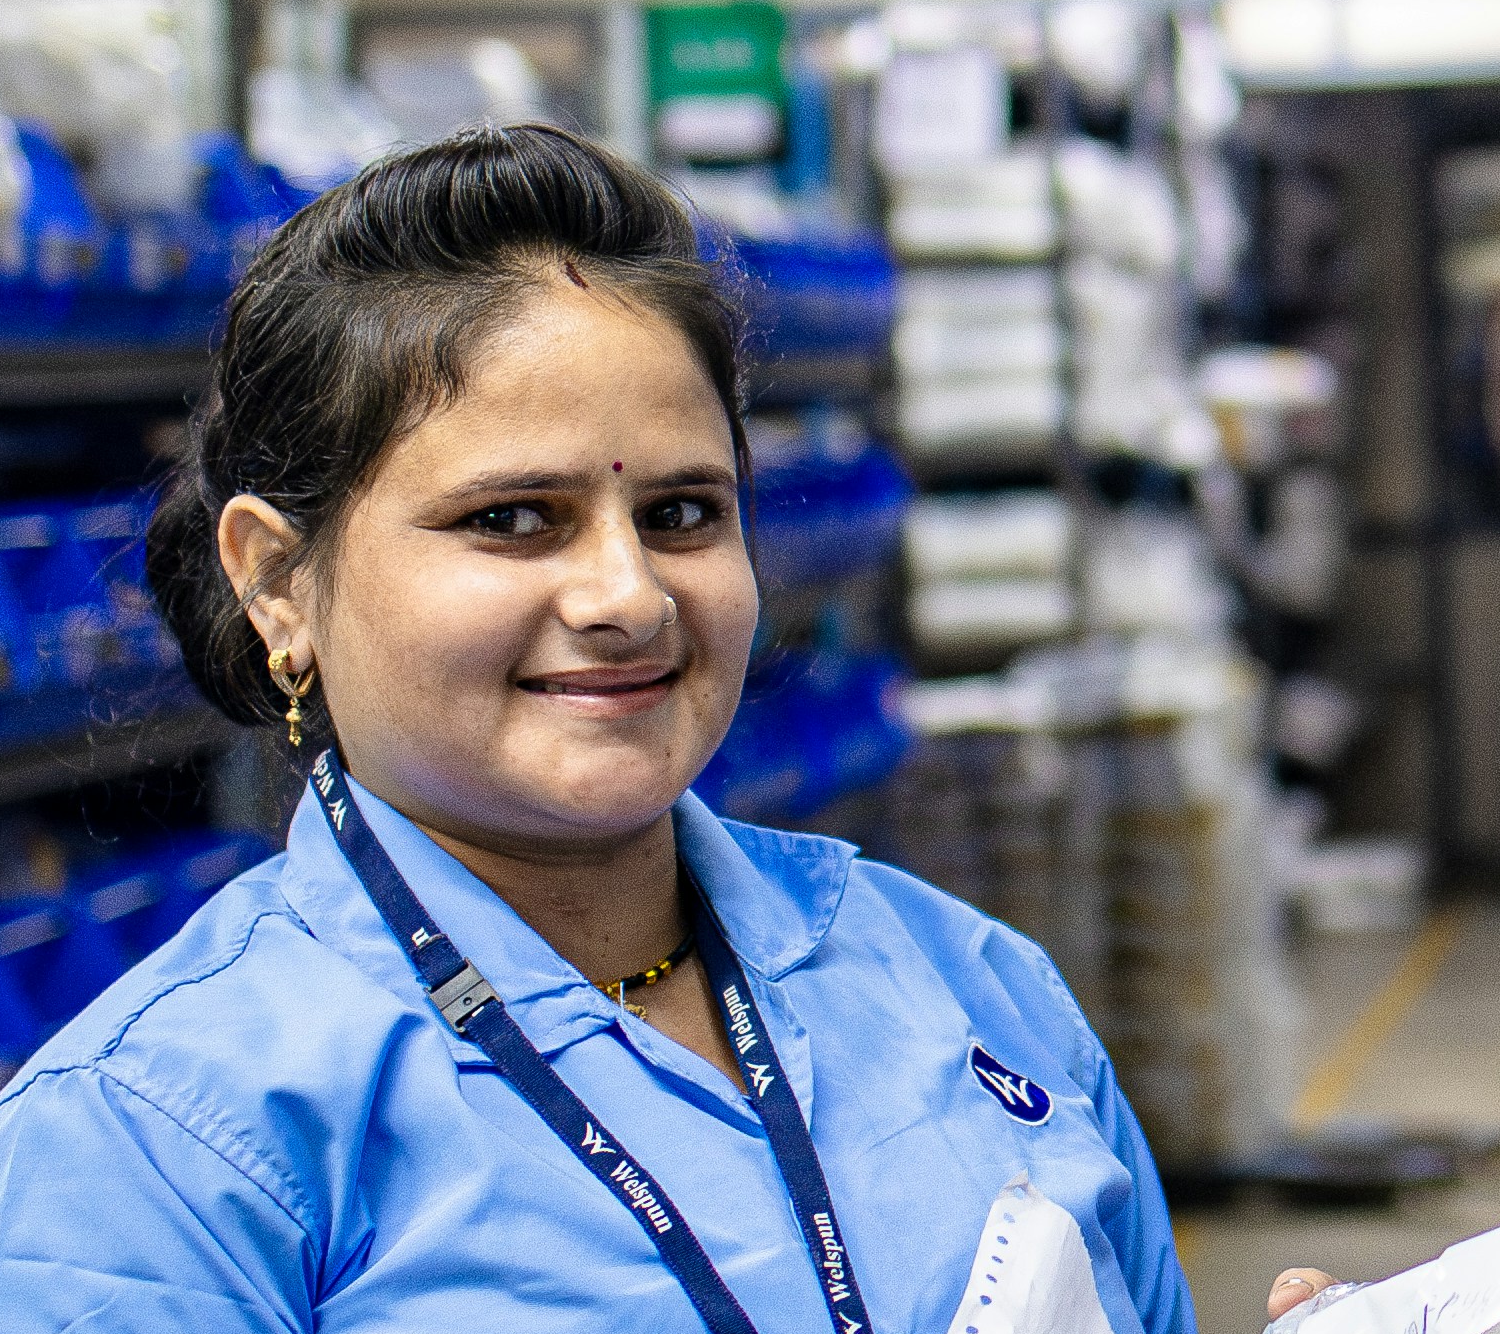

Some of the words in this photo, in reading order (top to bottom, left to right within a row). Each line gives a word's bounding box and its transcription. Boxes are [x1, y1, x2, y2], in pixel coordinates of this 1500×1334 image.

[723, 985, 759, 1055] Welspun
[610, 1160, 673, 1234] Welspun
[813, 1212, 851, 1303] Welspun
